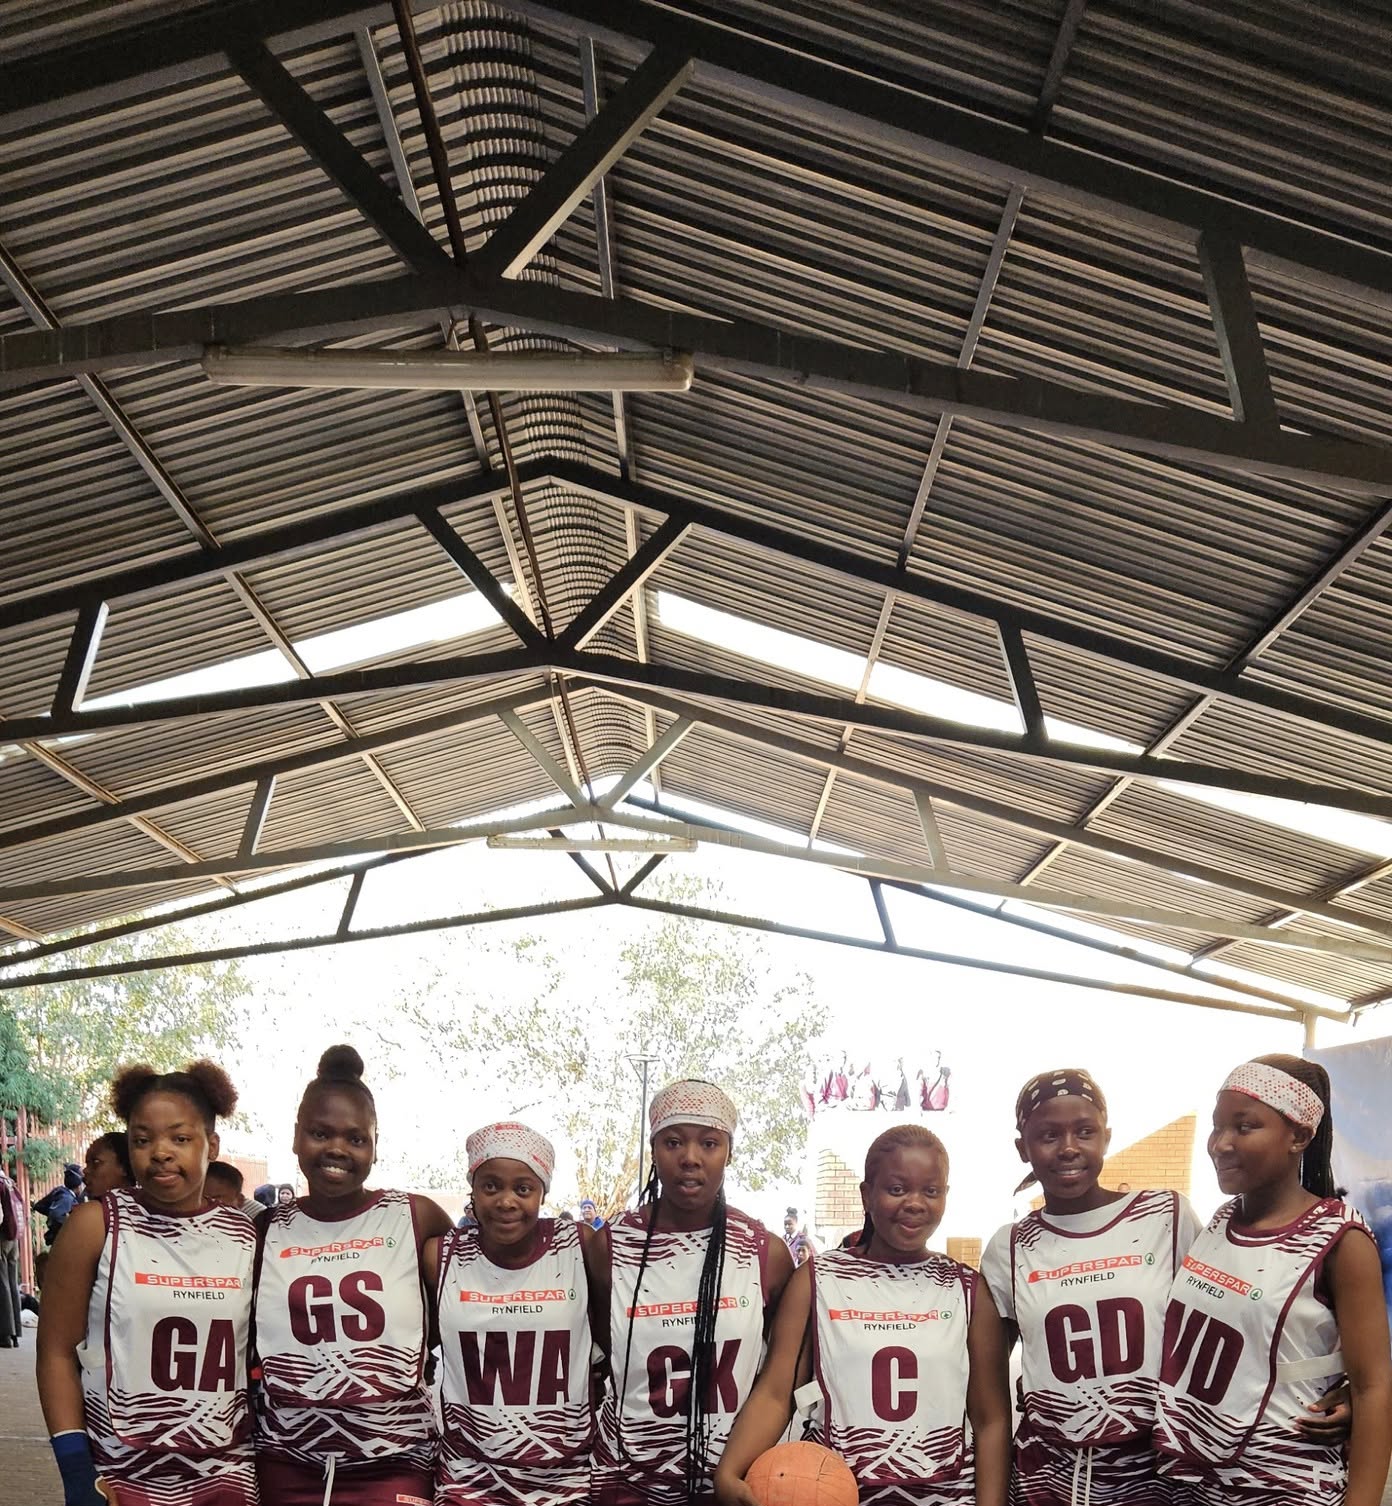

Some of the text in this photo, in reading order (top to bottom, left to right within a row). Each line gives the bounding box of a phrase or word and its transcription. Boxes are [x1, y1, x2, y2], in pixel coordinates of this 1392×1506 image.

[1038, 1255, 1140, 1280] SUPERSPAR
[1184, 1258, 1250, 1294] SUPERSPAR
[146, 1274, 243, 1289] SUPERSPAR
[1060, 1272, 1115, 1288] RYNFIELD
[1186, 1275, 1225, 1299] RYNFIELD
[173, 1289, 225, 1300] RYNFIELD
[468, 1289, 566, 1303] SUPERSPAR
[288, 1271, 386, 1346] GS
[492, 1304, 543, 1315] RYNFIELD
[637, 1297, 738, 1317] SUPERAR
[839, 1309, 938, 1322] SUPERSPAR
[863, 1322, 917, 1331] RYNFIELD
[1044, 1297, 1144, 1384] GD
[151, 1316, 236, 1393] GA
[458, 1330, 571, 1406] WA
[646, 1338, 742, 1419] GK
[871, 1346, 918, 1423] C
